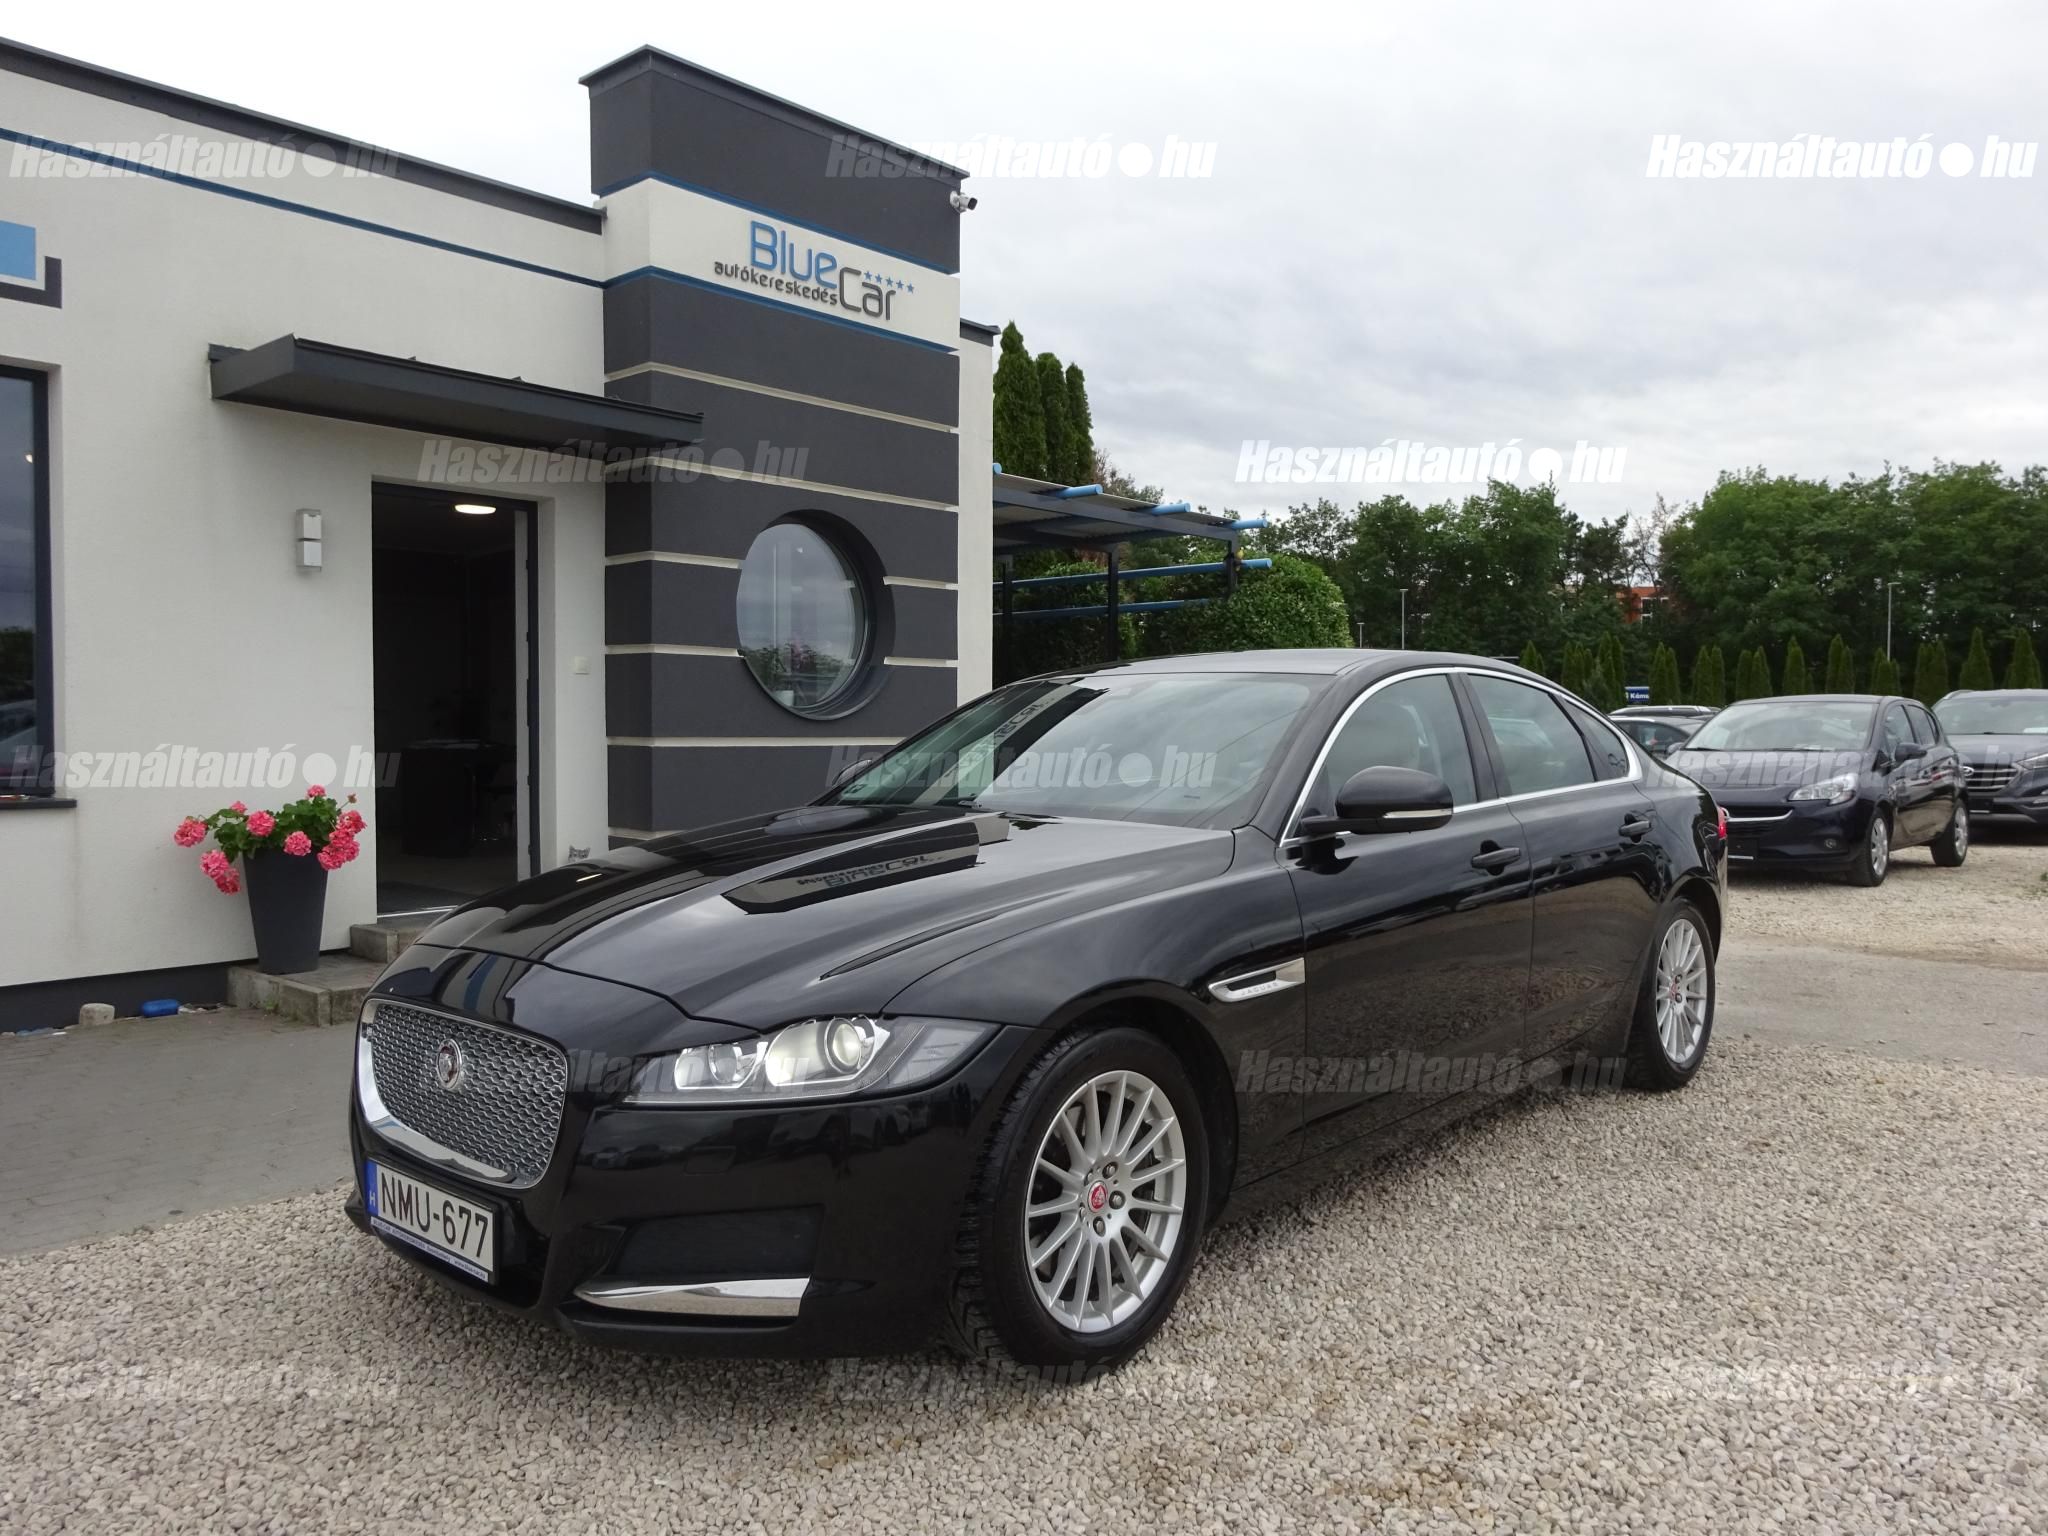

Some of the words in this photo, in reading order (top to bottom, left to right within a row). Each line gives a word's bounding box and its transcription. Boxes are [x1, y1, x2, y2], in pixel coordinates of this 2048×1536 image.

[714, 261, 838, 305] autókereskedés
[1241, 981, 1280, 996] JAGUAR
[381, 1172, 488, 1258] NMU-677
